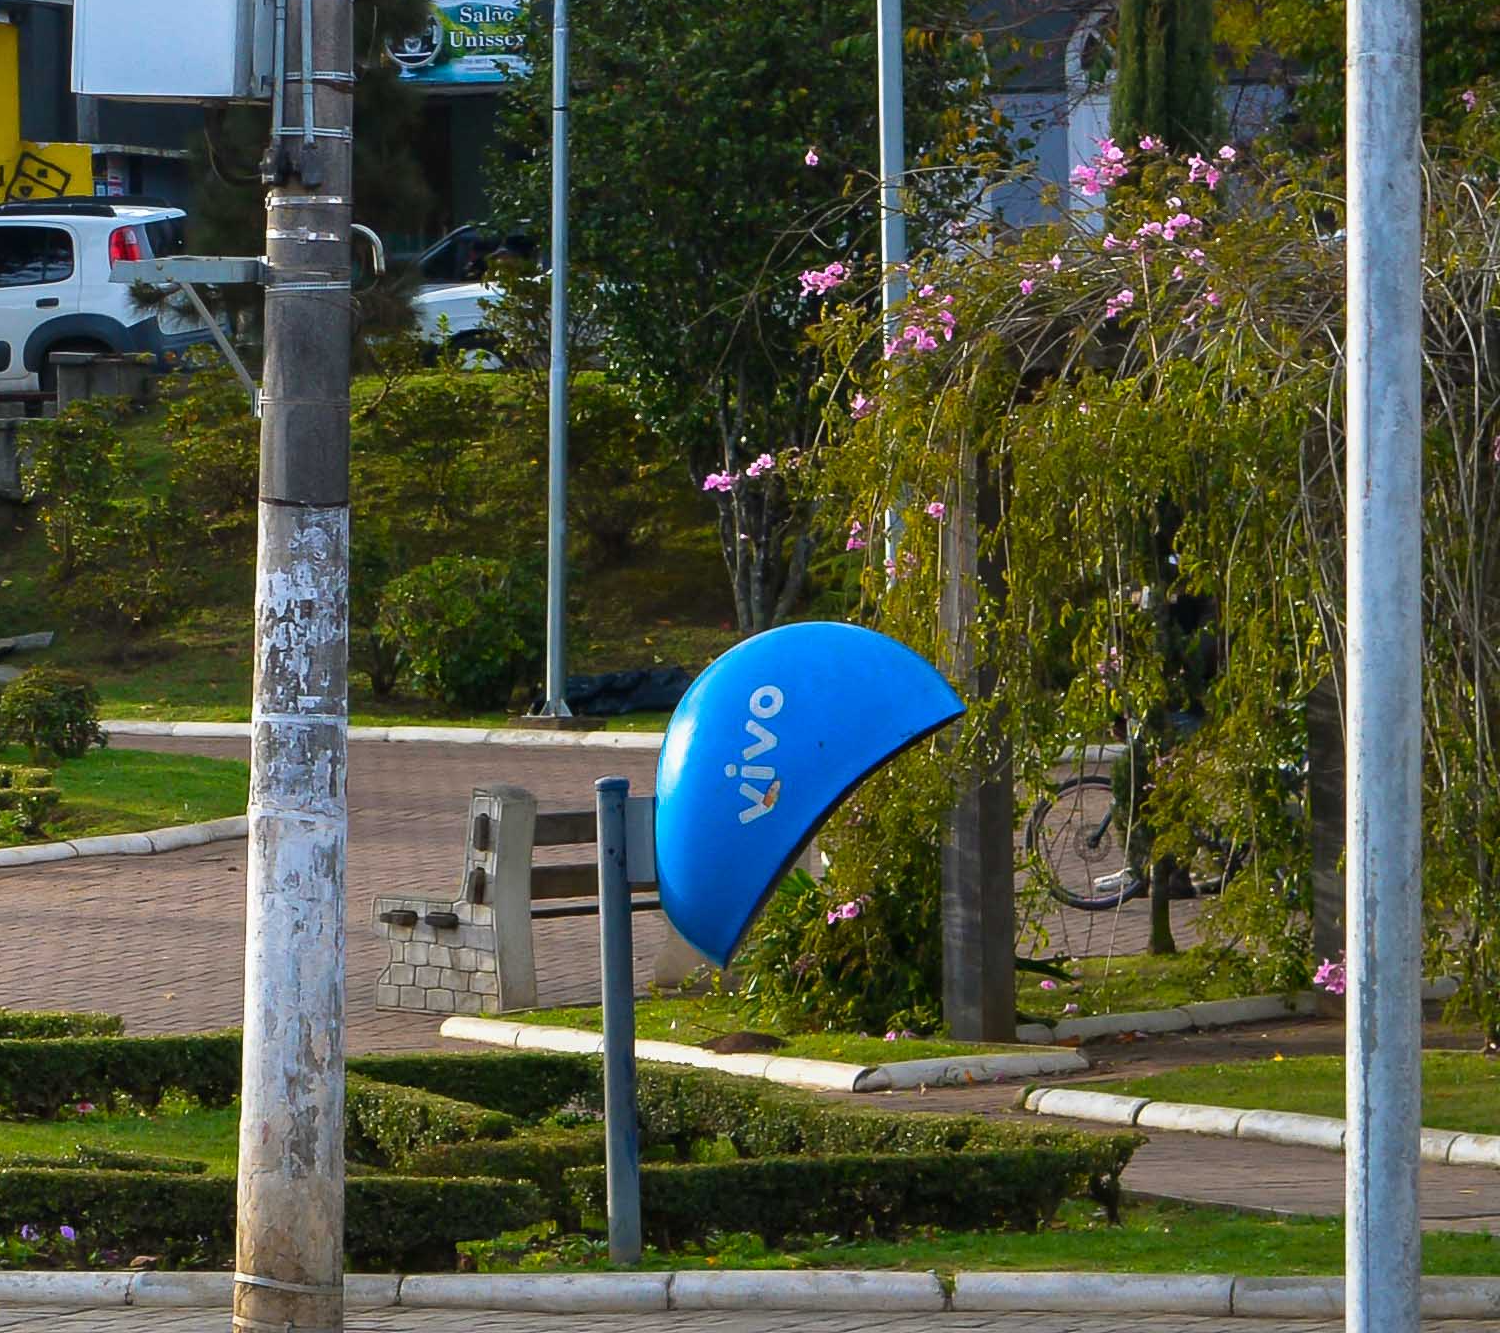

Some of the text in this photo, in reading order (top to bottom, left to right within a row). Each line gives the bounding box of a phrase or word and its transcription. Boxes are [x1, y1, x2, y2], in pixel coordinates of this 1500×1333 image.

[460, 6, 515, 23] Salão
[450, 31, 526, 47] Unissex
[724, 685, 784, 824] vivo
